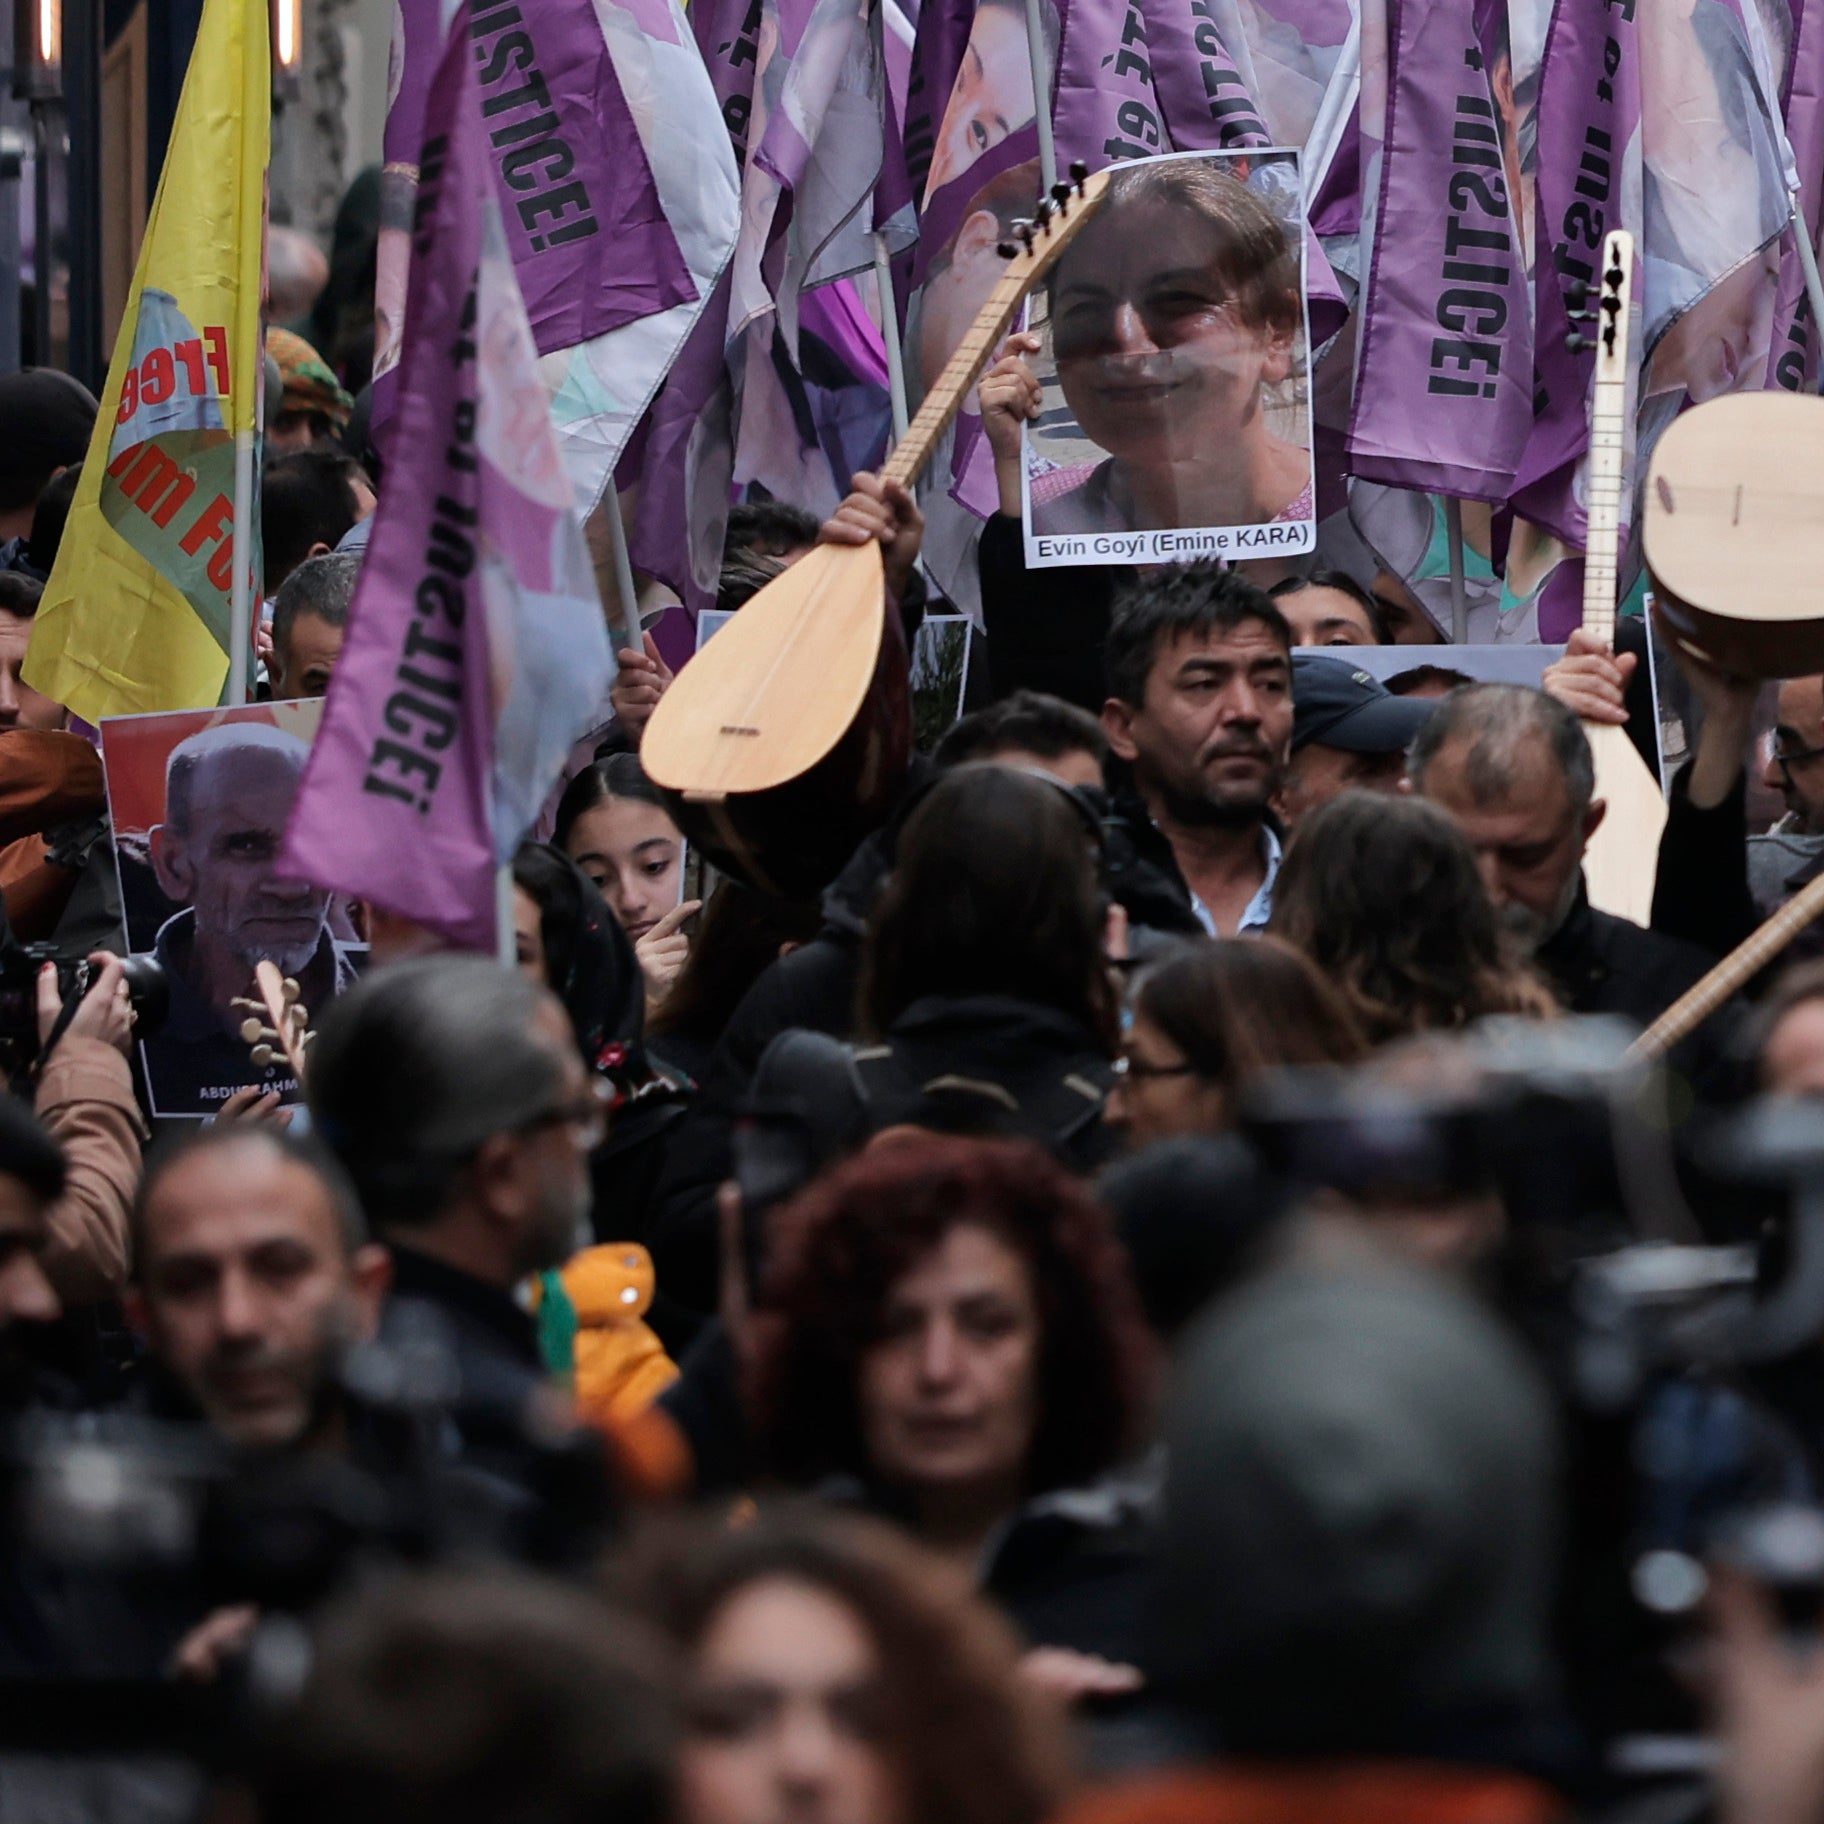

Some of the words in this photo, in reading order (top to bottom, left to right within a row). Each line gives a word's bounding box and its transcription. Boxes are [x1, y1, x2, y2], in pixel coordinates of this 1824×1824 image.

[1038, 538, 1086, 557] Evin
[1094, 534, 1146, 558] Goyî
[1152, 532, 1229, 555] (Emine
[1236, 524, 1308, 547] KARA)
